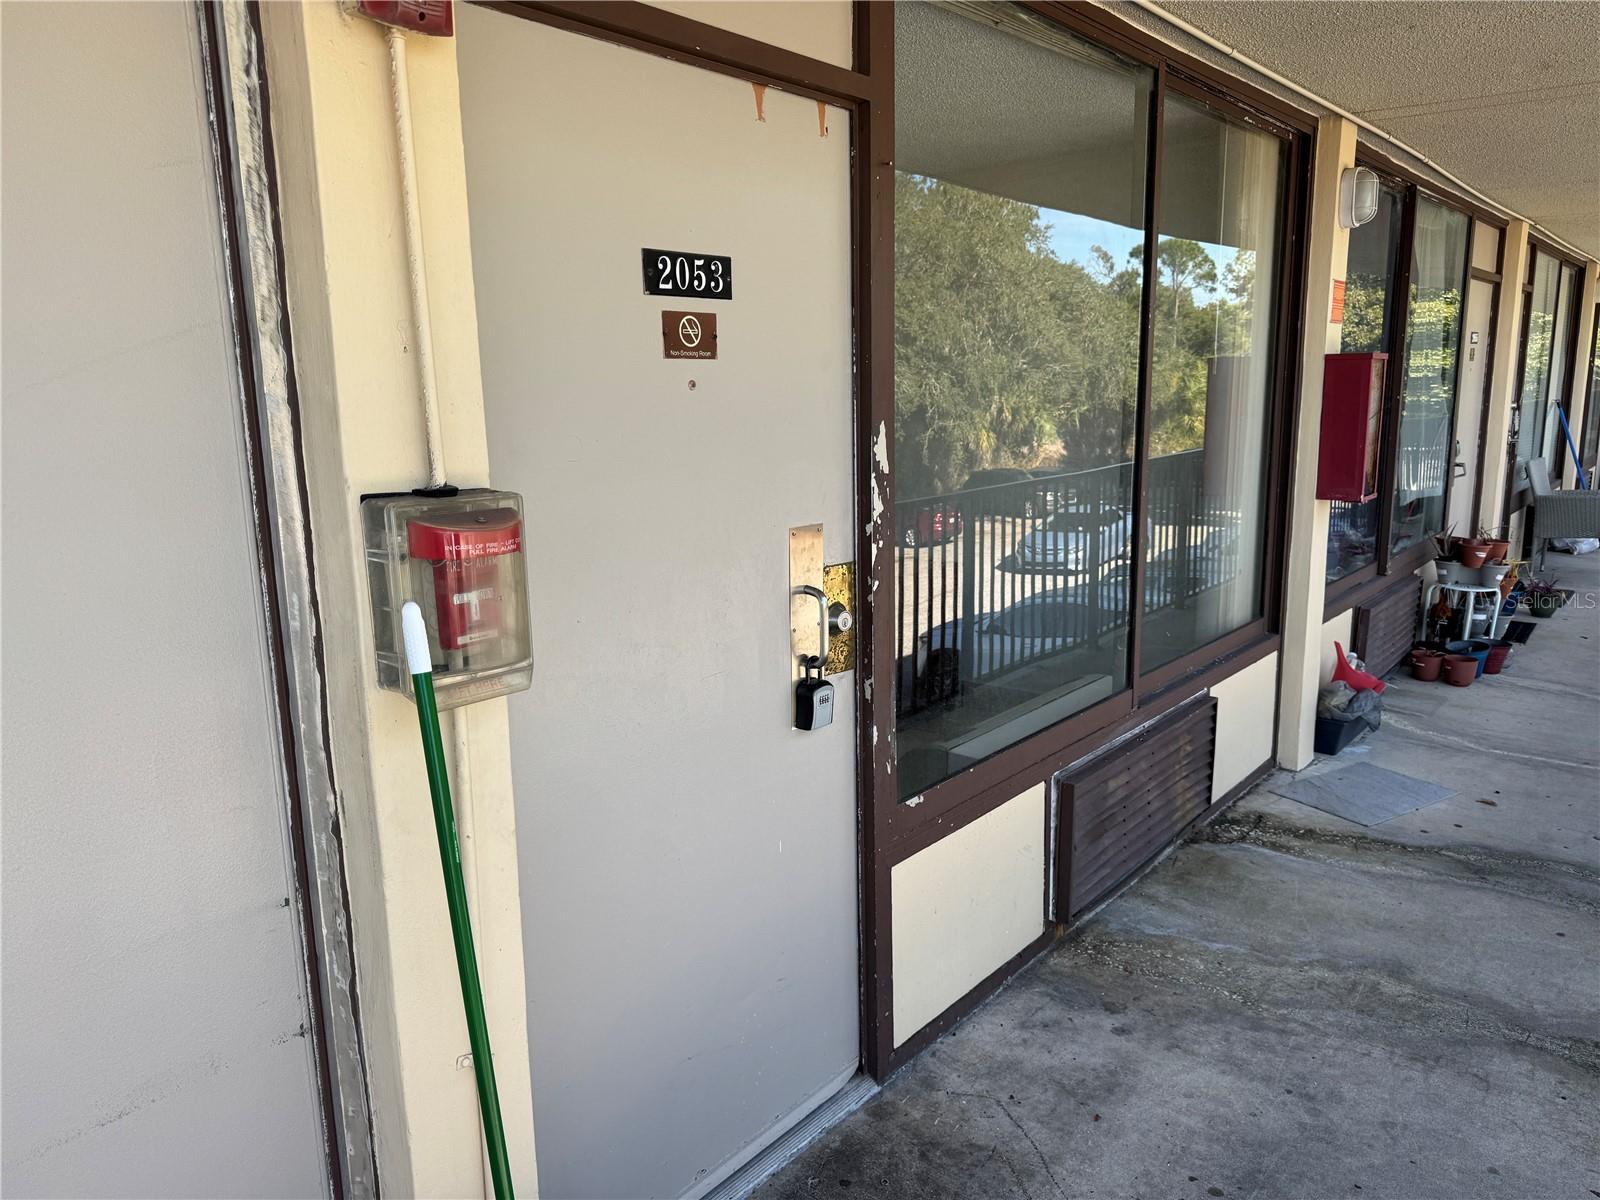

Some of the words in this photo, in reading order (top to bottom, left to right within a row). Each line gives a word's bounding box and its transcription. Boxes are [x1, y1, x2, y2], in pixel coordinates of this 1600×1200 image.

[657, 255, 724, 293] 2053
[670, 350, 699, 358] Non-Smoking
[469, 548, 485, 556] PULL
